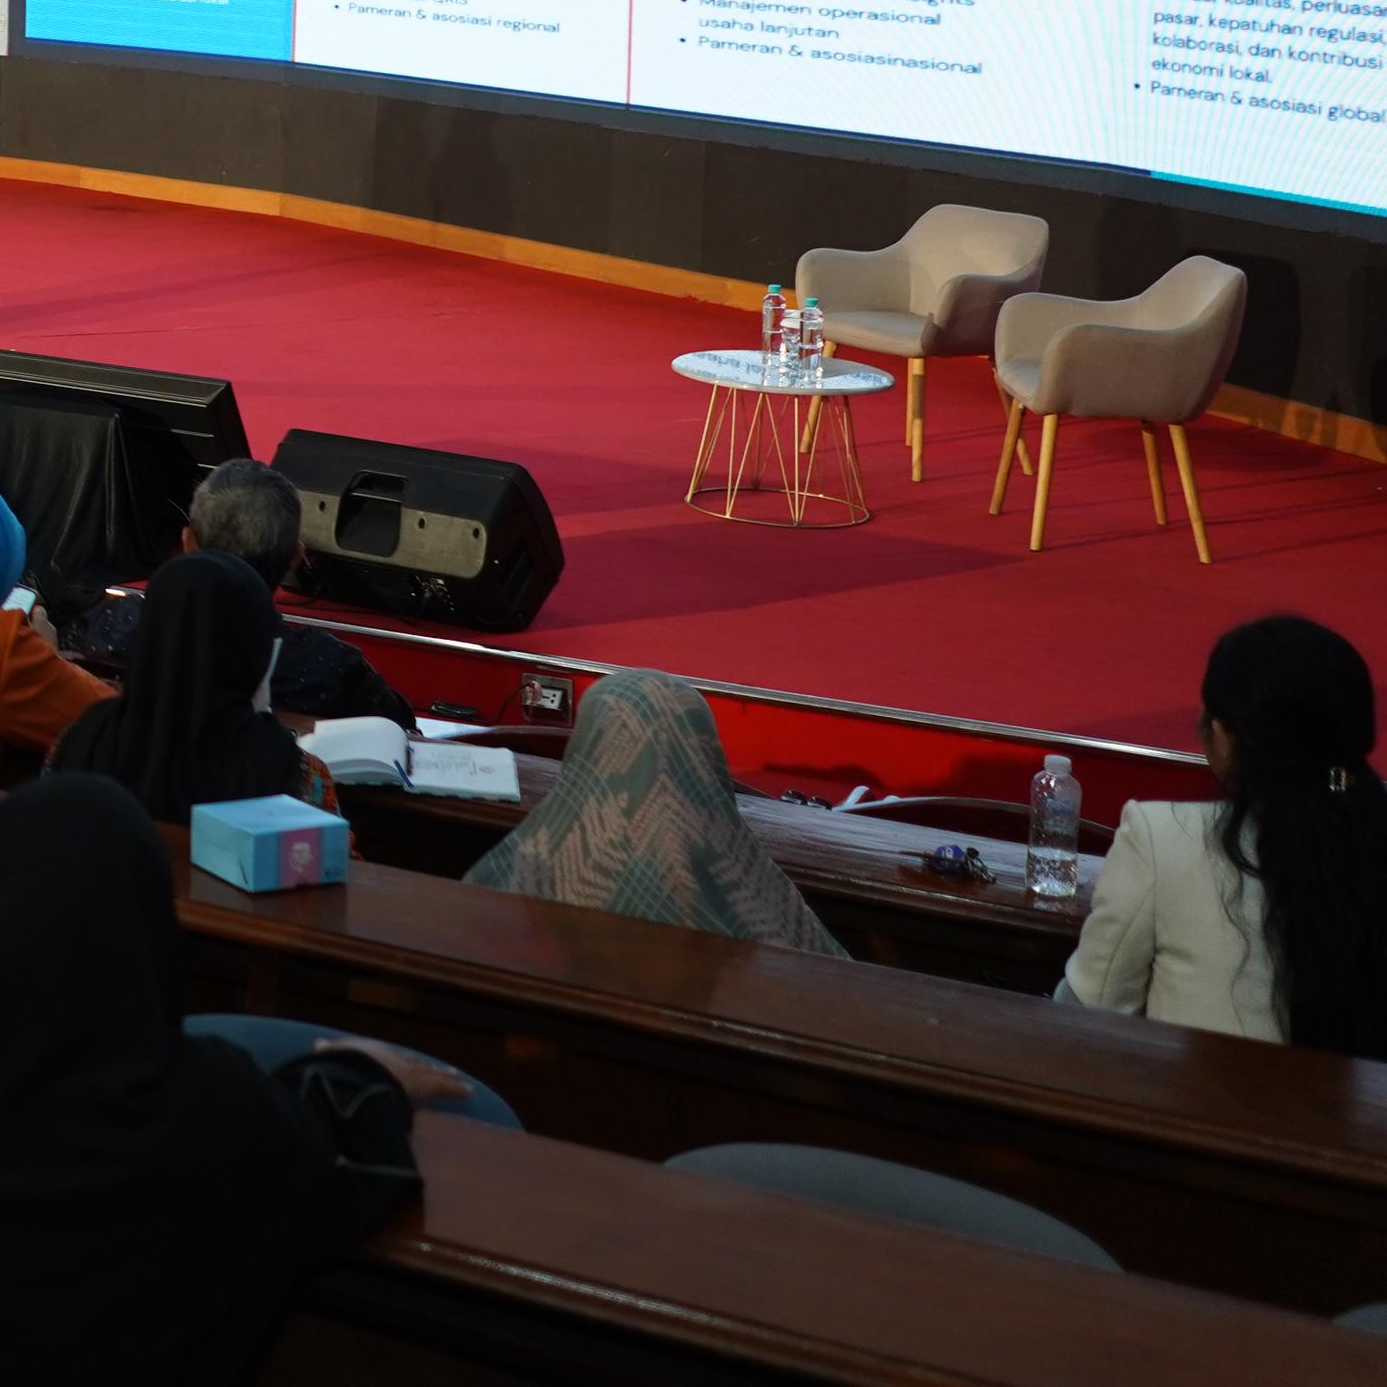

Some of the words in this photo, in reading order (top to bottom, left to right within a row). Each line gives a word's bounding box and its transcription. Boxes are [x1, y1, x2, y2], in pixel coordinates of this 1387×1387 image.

[349, 2, 411, 18] Pameran
[416, 9, 426, 19] &
[432, 12, 492, 26] asosiasi
[496, 17, 559, 33] regional
[818, 4, 941, 26] operasional
[1209, 15, 1303, 36] kepatuhan
[699, 16, 753, 31] usaha
[760, 21, 839, 40] lanjutan
[698, 35, 782, 55] Pameran
[789, 43, 803, 57] &
[1249, 43, 1282, 58] dan
[1287, 47, 1383, 69] kontribusi
[1152, 60, 1224, 78] ekonomi
[1151, 81, 1224, 102] Pameran
[1231, 92, 1243, 105] &
[1249, 96, 1322, 115] asosiasi
[1328, 105, 1386, 122] global
